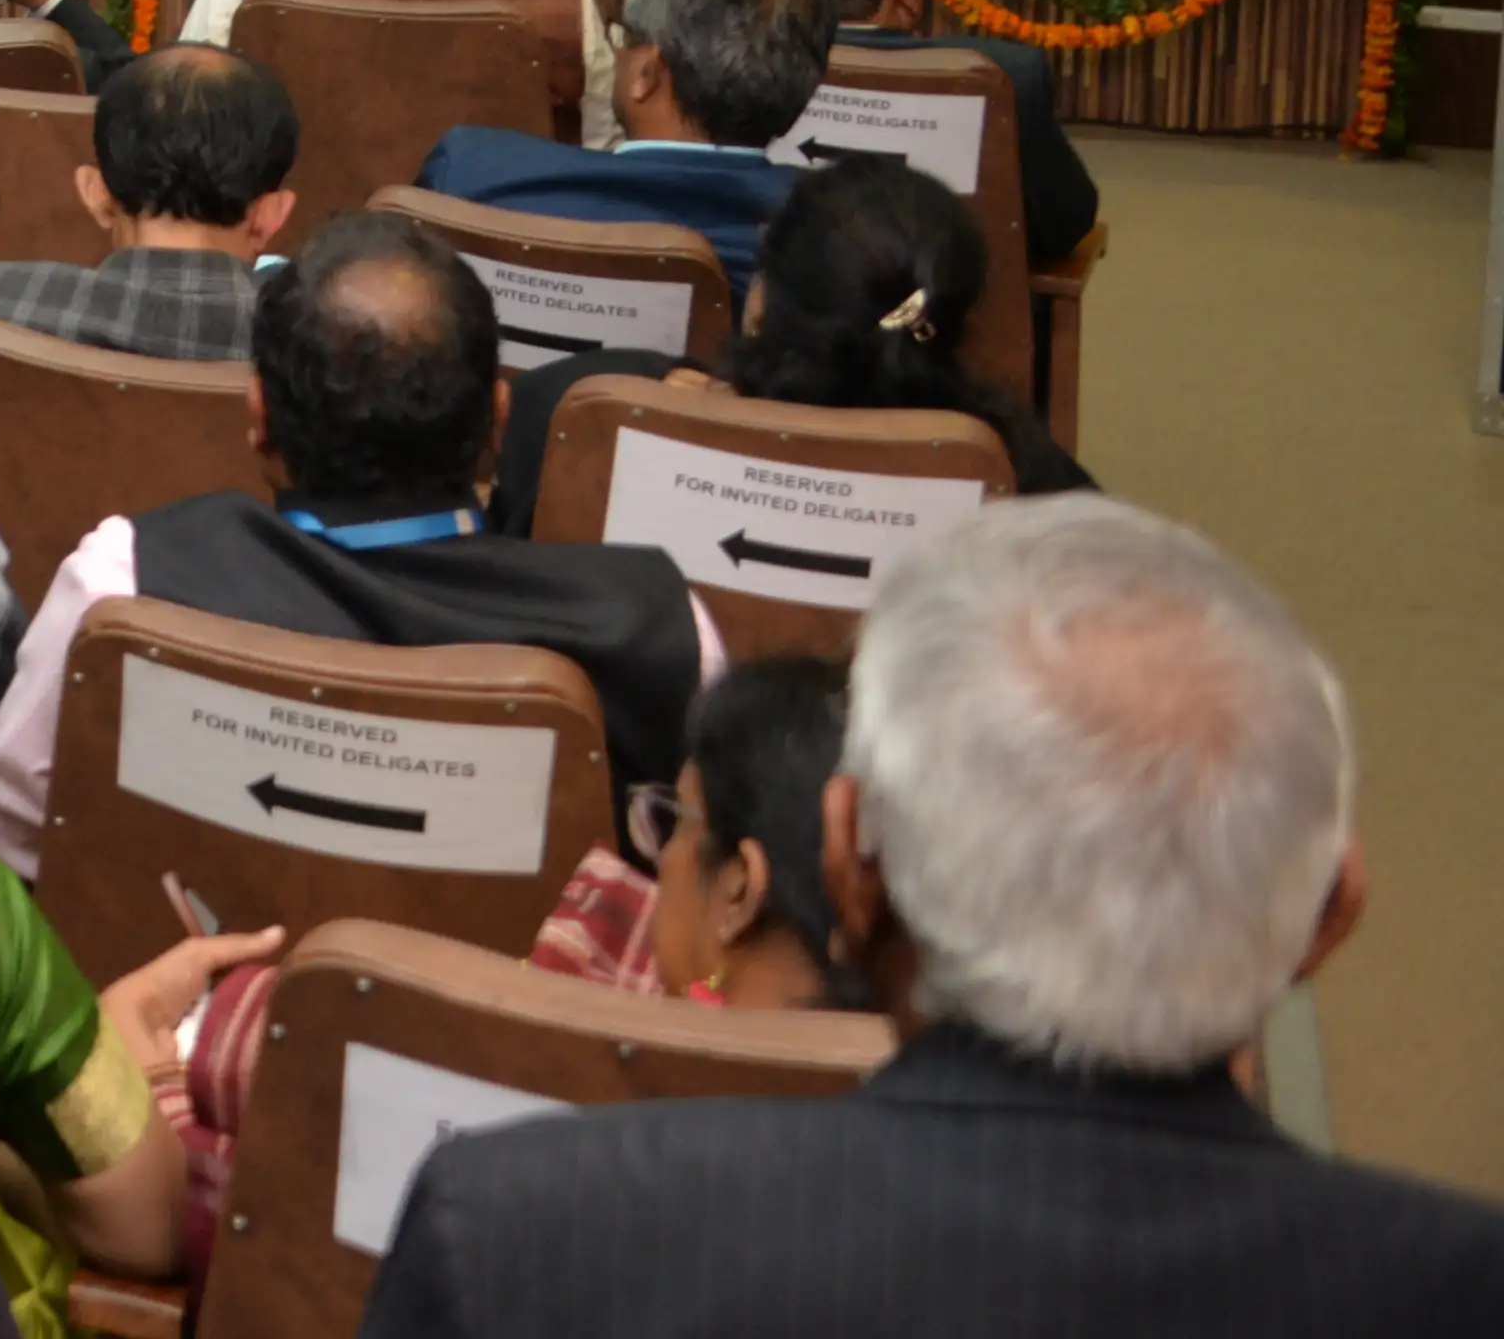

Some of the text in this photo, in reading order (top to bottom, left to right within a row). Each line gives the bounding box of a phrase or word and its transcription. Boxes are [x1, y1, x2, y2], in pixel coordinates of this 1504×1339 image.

[496, 269, 583, 294] RESERVED
[545, 297, 637, 318] DELIGATES
[743, 466, 852, 498] RESERVED
[674, 473, 917, 528] FOR INVITED DELIGATES
[270, 706, 397, 745] RESERVED
[192, 709, 476, 778] FOR INVITED DELIGATES
